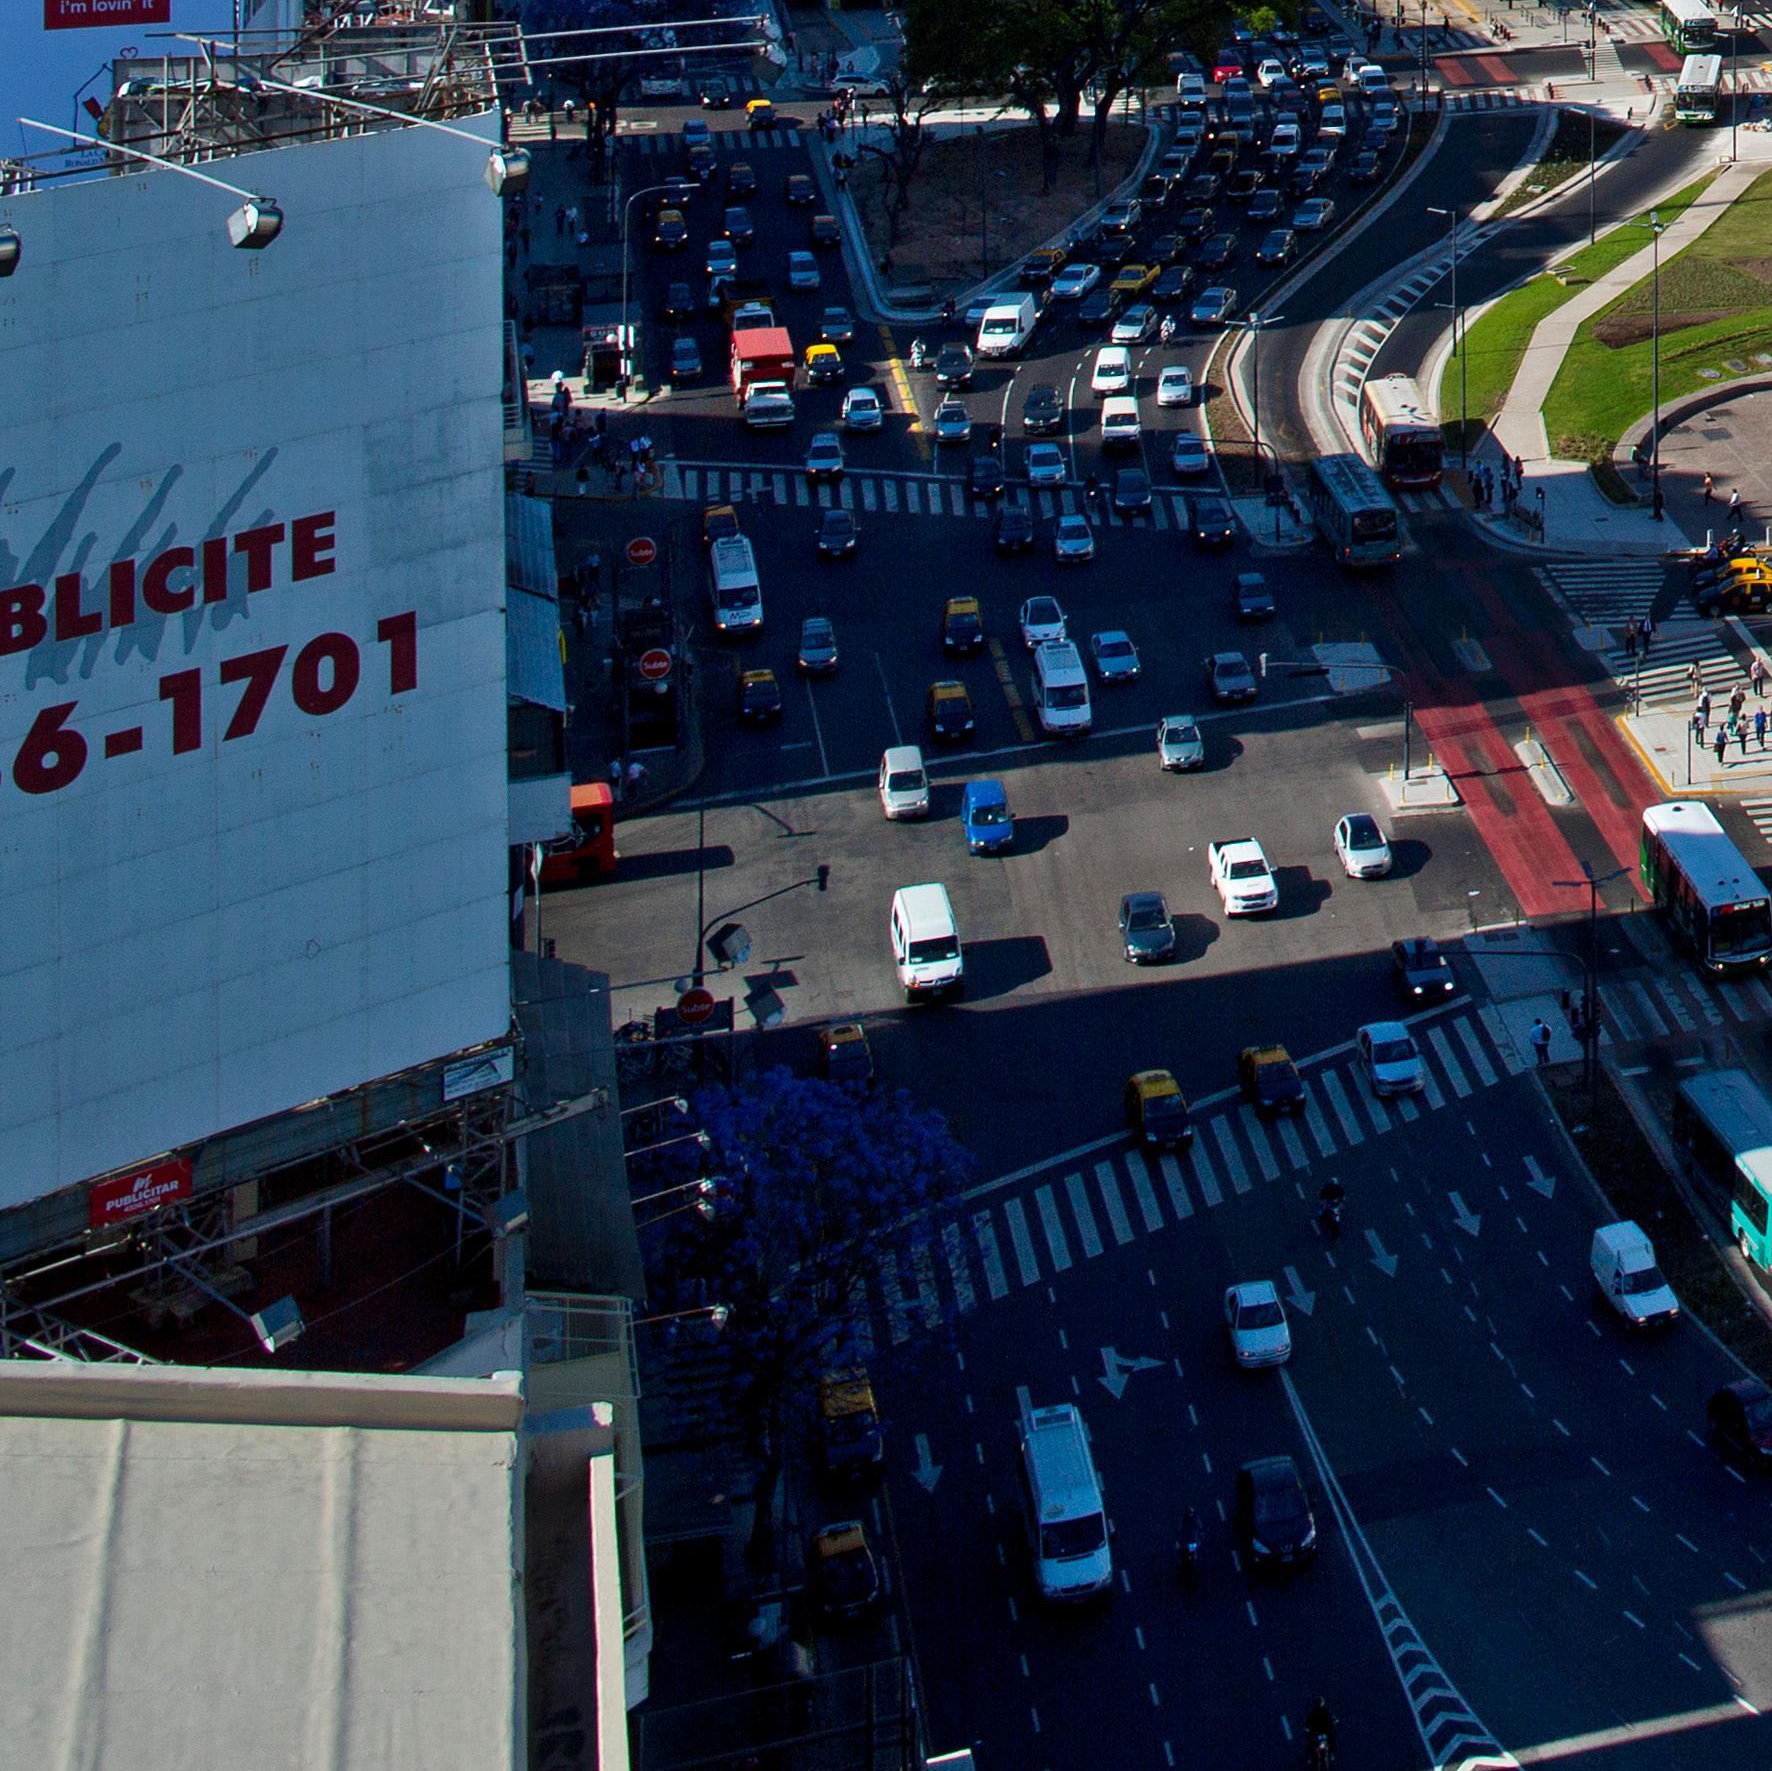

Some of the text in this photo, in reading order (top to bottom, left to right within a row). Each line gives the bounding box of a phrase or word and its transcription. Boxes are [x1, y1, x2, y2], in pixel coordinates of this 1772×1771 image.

[60, 1, 87, 15] i'm
[0, 510, 336, 657] BLICITE
[643, 660, 668, 670] Subte
[105, 1180, 180, 1212] PUBLICITAR
